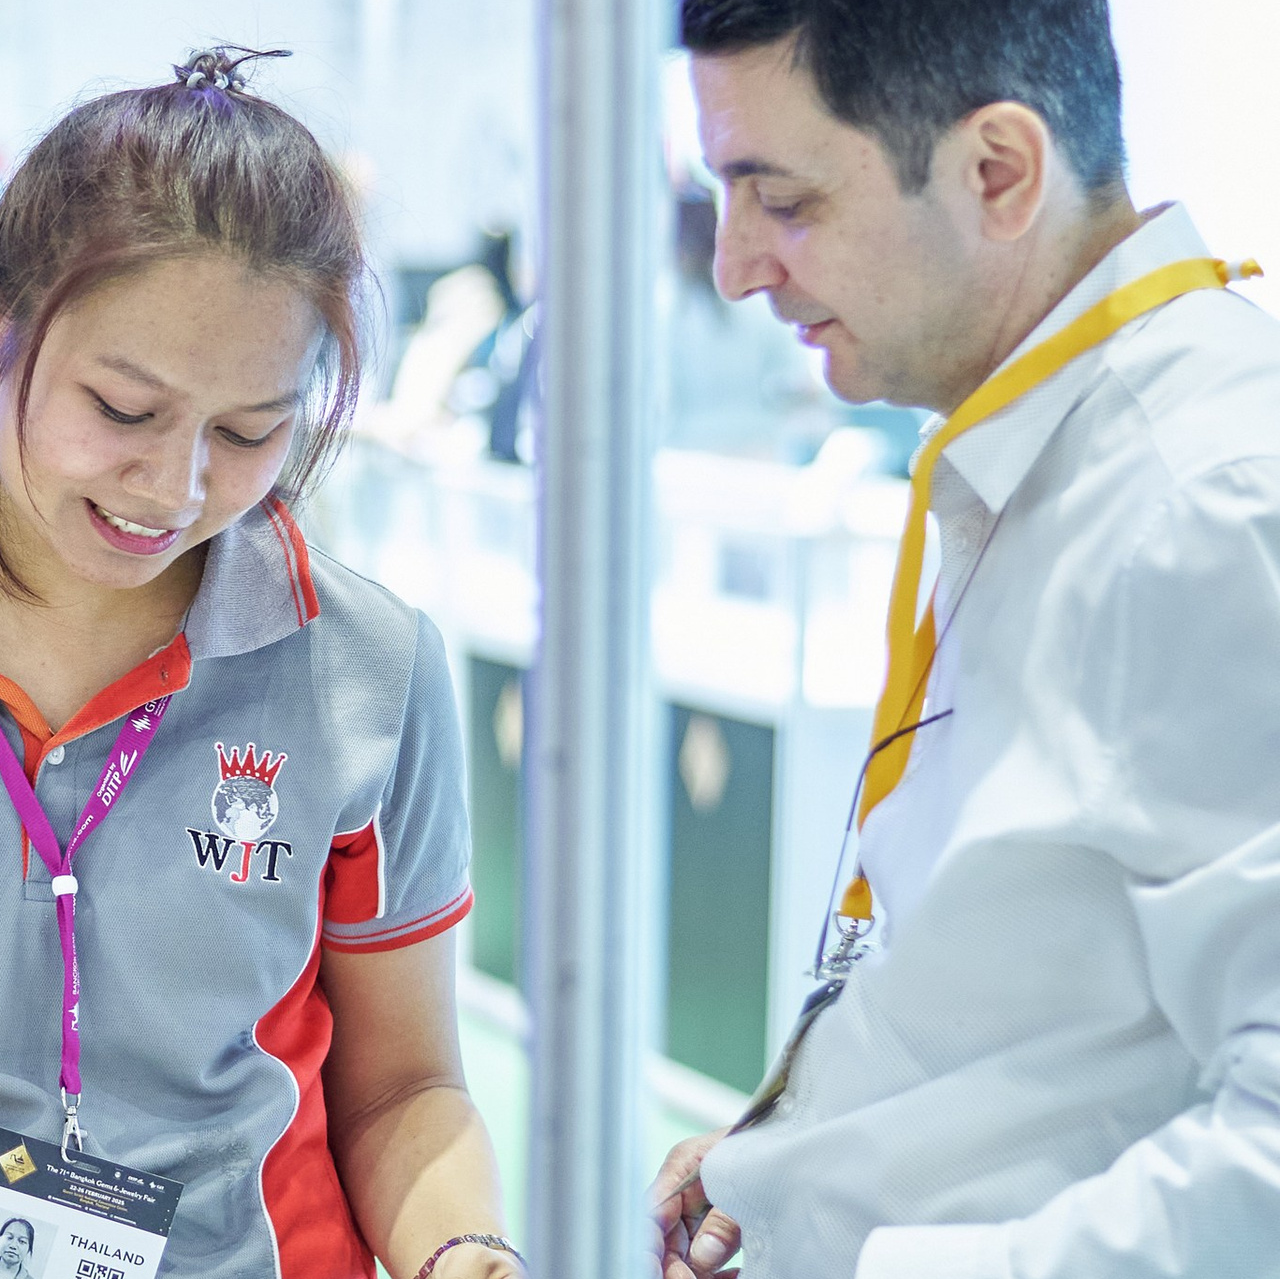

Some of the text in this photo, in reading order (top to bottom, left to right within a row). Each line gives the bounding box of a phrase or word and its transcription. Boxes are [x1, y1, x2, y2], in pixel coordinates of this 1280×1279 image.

[96, 762, 117, 797] Organized by
[101, 771, 122, 807] DITP
[186, 827, 293, 883] WJT
[46, 1164, 59, 1174] The
[70, 1171, 96, 1185] Bangkok
[96, 1179, 114, 1190] Gems
[119, 1187, 143, 1201] Jewelry
[143, 1194, 156, 1203] Fair
[85, 1188, 111, 1203] FEBRUARY
[70, 1234, 145, 1266] THAILAND
